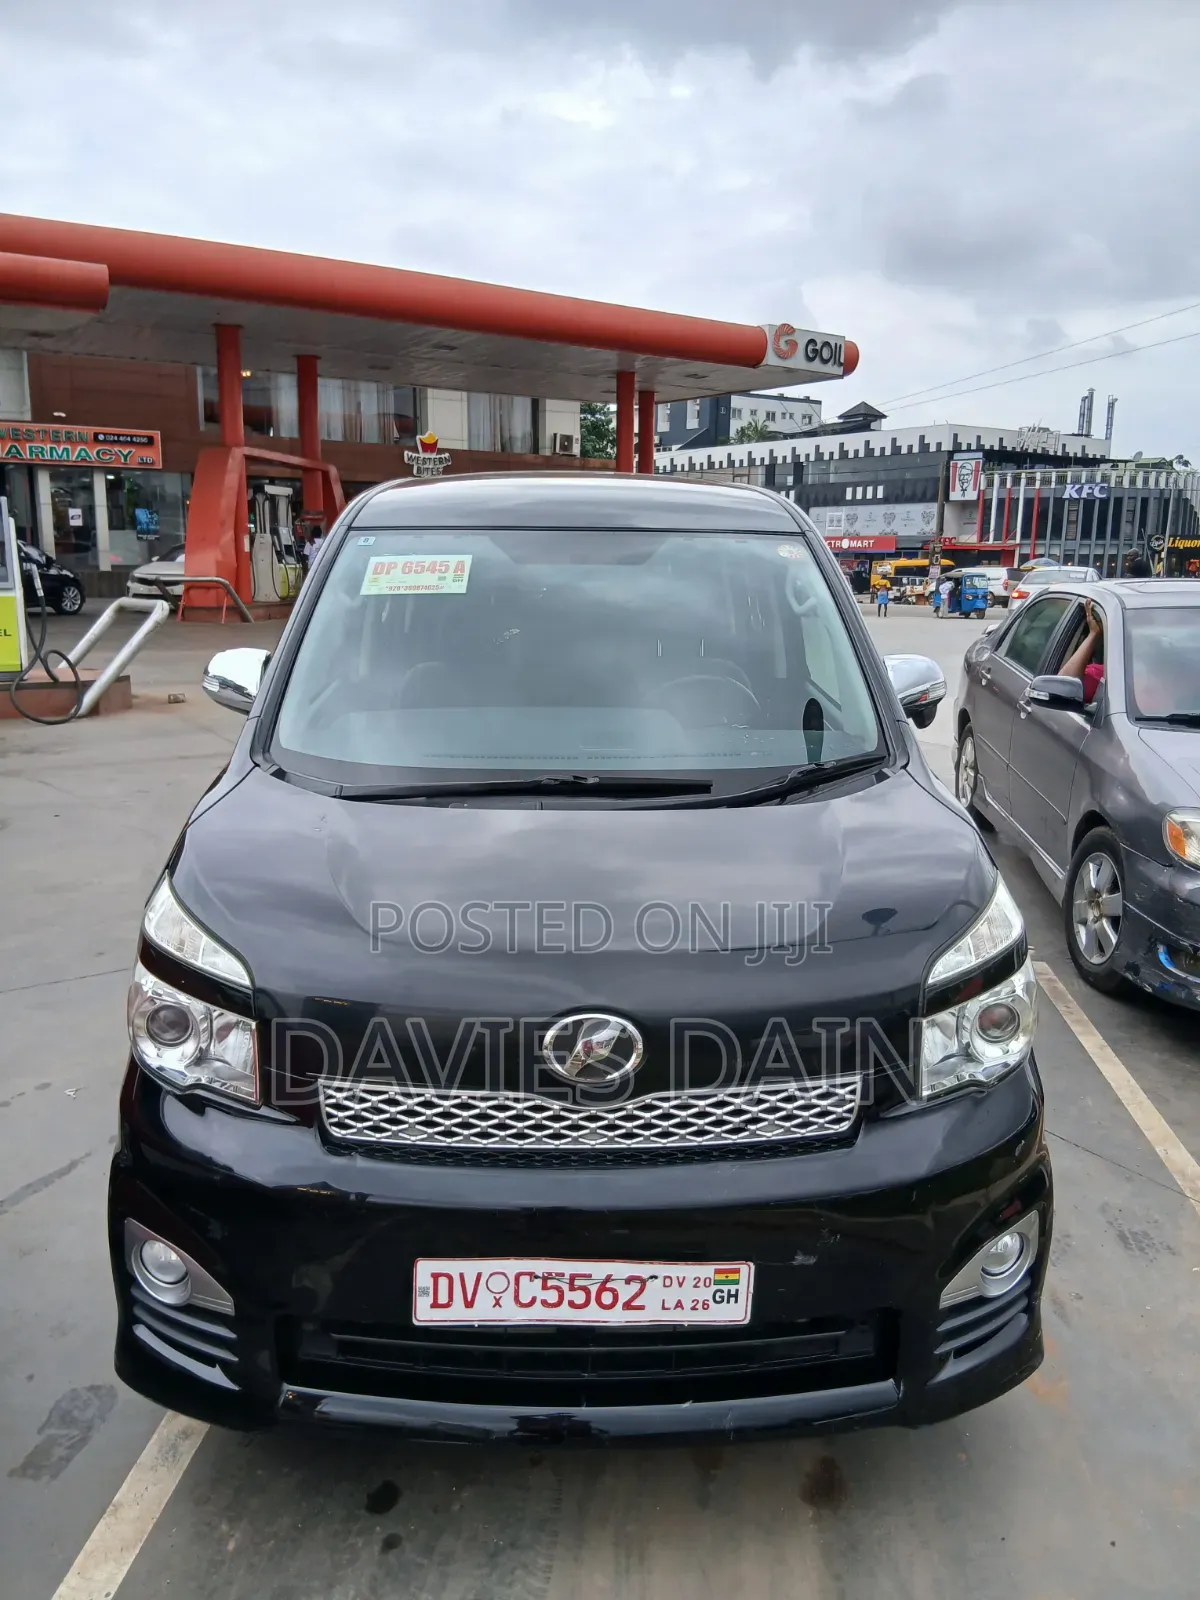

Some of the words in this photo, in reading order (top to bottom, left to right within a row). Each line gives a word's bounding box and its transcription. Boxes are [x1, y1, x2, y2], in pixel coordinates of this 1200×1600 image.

[805, 338, 844, 367] GOIL
[0, 443, 136, 464] ARMACY
[406, 452, 450, 466] WESTERN
[416, 465, 442, 476] BITES
[1062, 483, 1108, 499] KFC
[371, 561, 399, 576] DP
[401, 560, 450, 575] 6545
[453, 560, 466, 573] A
[662, 1275, 686, 1288] DV
[692, 1276, 712, 1289] 20
[430, 1272, 482, 1309] DV
[513, 1271, 648, 1311] C5562
[712, 1288, 739, 1305] GH
[661, 1299, 685, 1311] LA
[690, 1299, 710, 1311] 26
